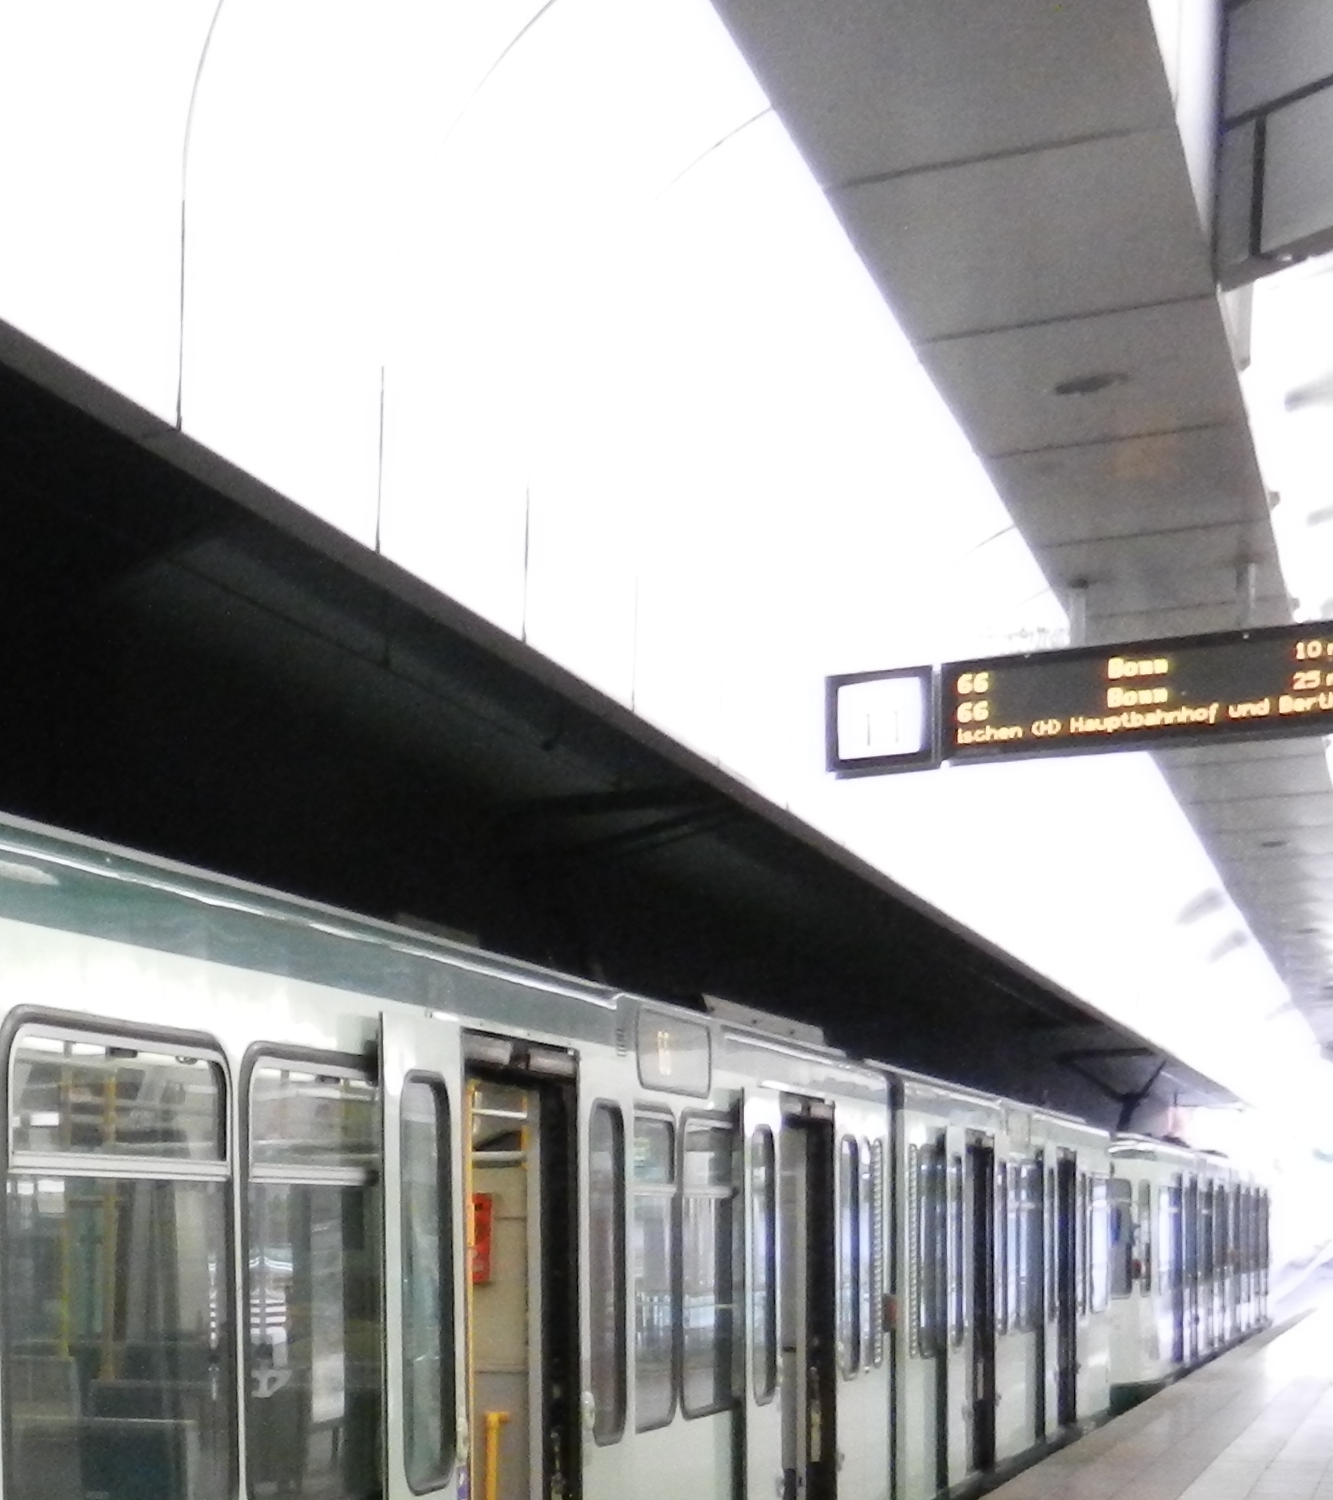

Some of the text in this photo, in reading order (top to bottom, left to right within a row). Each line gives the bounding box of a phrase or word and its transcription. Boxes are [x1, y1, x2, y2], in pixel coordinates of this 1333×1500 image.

[957, 672, 990, 694] 66
[1107, 656, 1169, 680] Bonn
[1295, 641, 1322, 660] 10
[957, 701, 989, 724] 66
[1106, 687, 1169, 708] Bonn
[1292, 669, 1321, 690] 25
[1069, 702, 1219, 733] Hauptbahnhof
[1228, 698, 1270, 718] und
